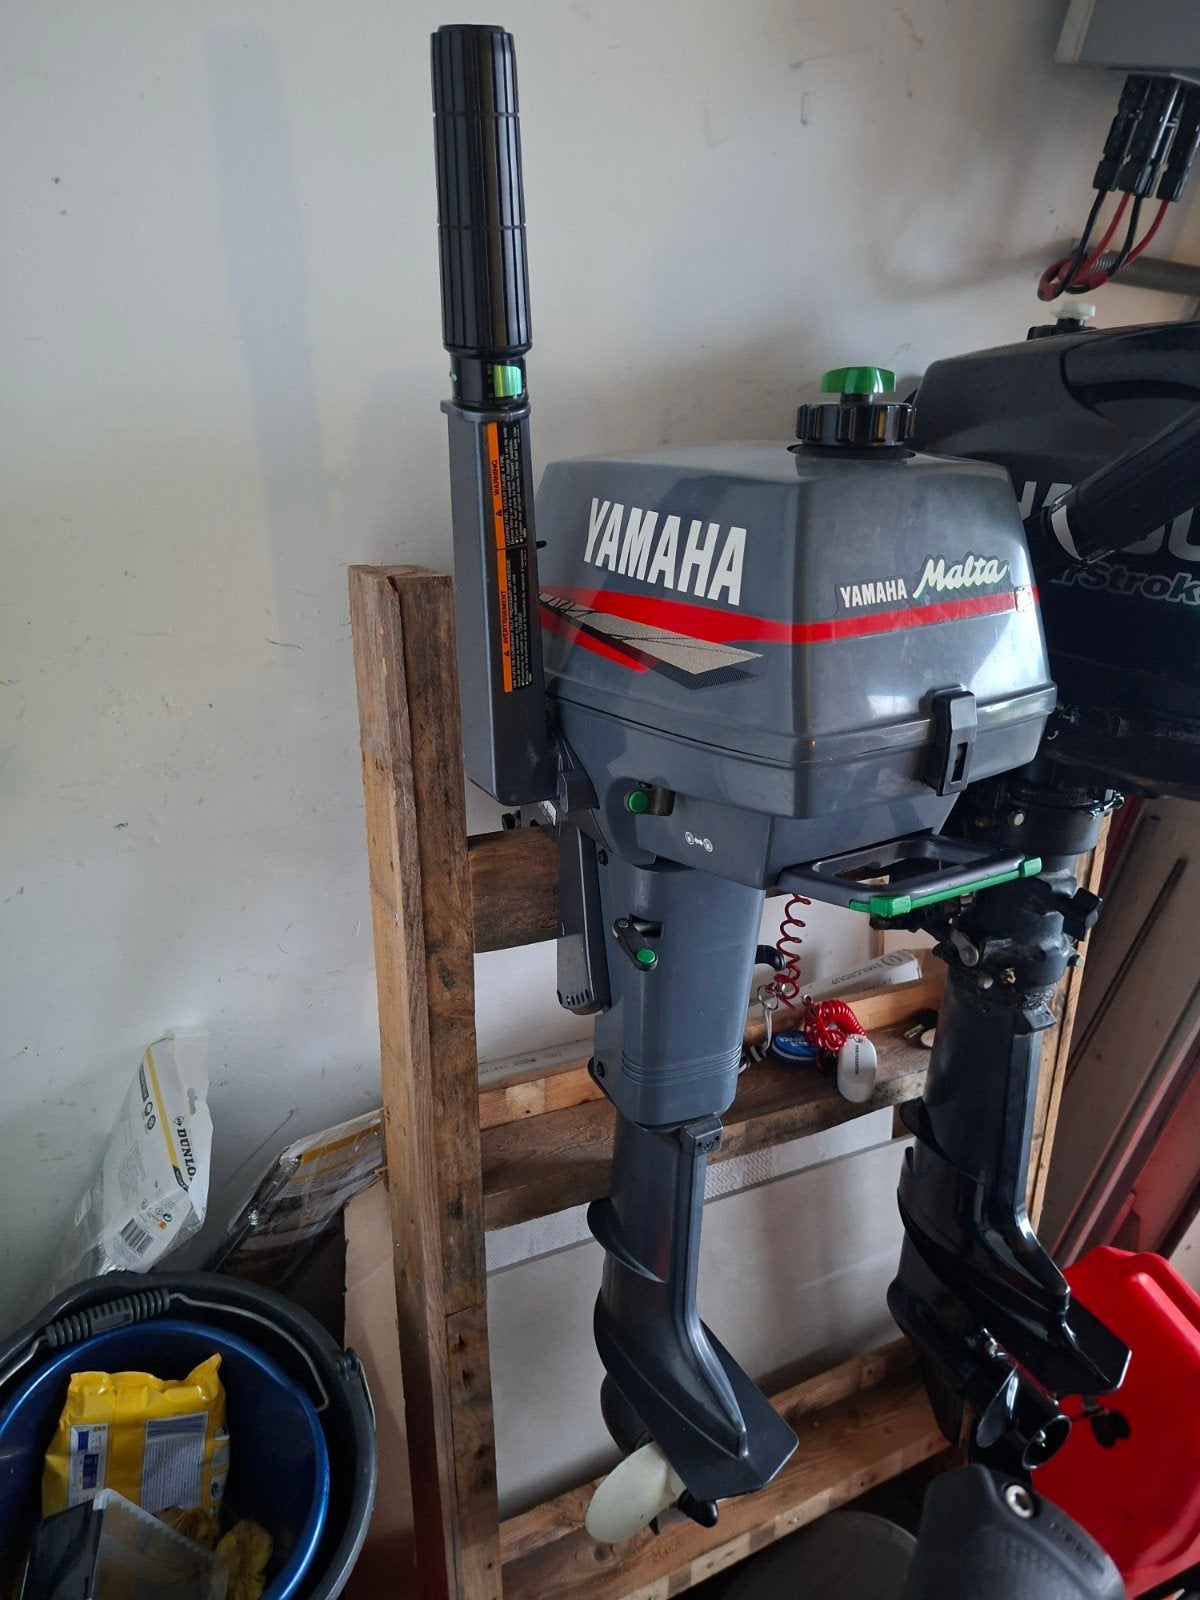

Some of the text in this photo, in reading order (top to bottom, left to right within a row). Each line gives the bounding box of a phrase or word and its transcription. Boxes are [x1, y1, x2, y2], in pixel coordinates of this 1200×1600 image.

[492, 459, 500, 496] WARNING
[583, 497, 747, 606] YAMAHA
[839, 554, 1009, 608] YAMAHA Malta
[177, 1128, 197, 1182] DUNLO
